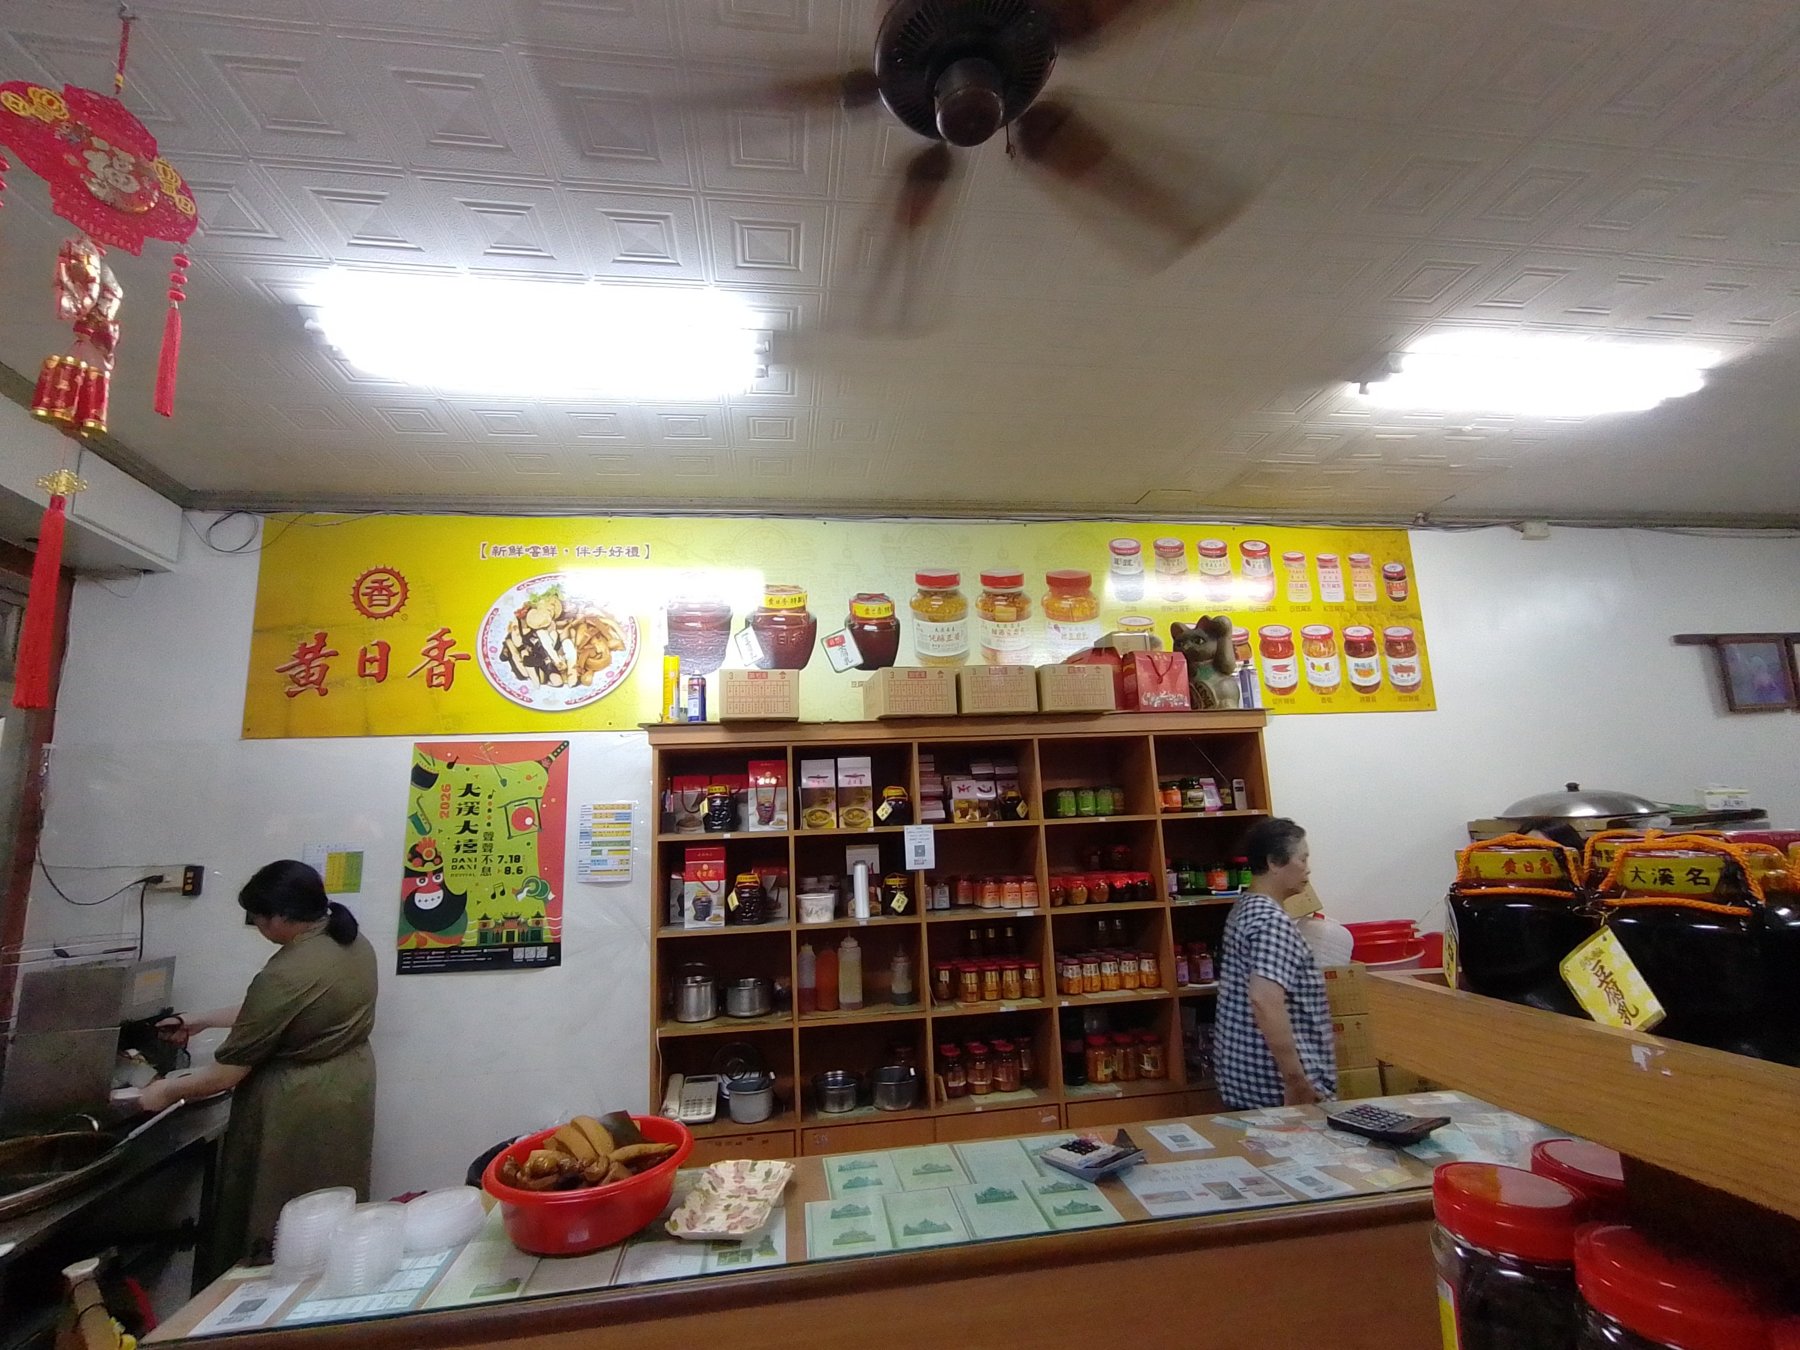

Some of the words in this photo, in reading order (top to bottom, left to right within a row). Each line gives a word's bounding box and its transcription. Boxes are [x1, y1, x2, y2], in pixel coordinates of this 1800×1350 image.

[361, 577, 399, 607] 香
[439, 783, 451, 819] 2026
[497, 854, 521, 864] 7.18
[1501, 857, 1554, 875] 黃日香
[504, 866, 524, 875] 8.6
